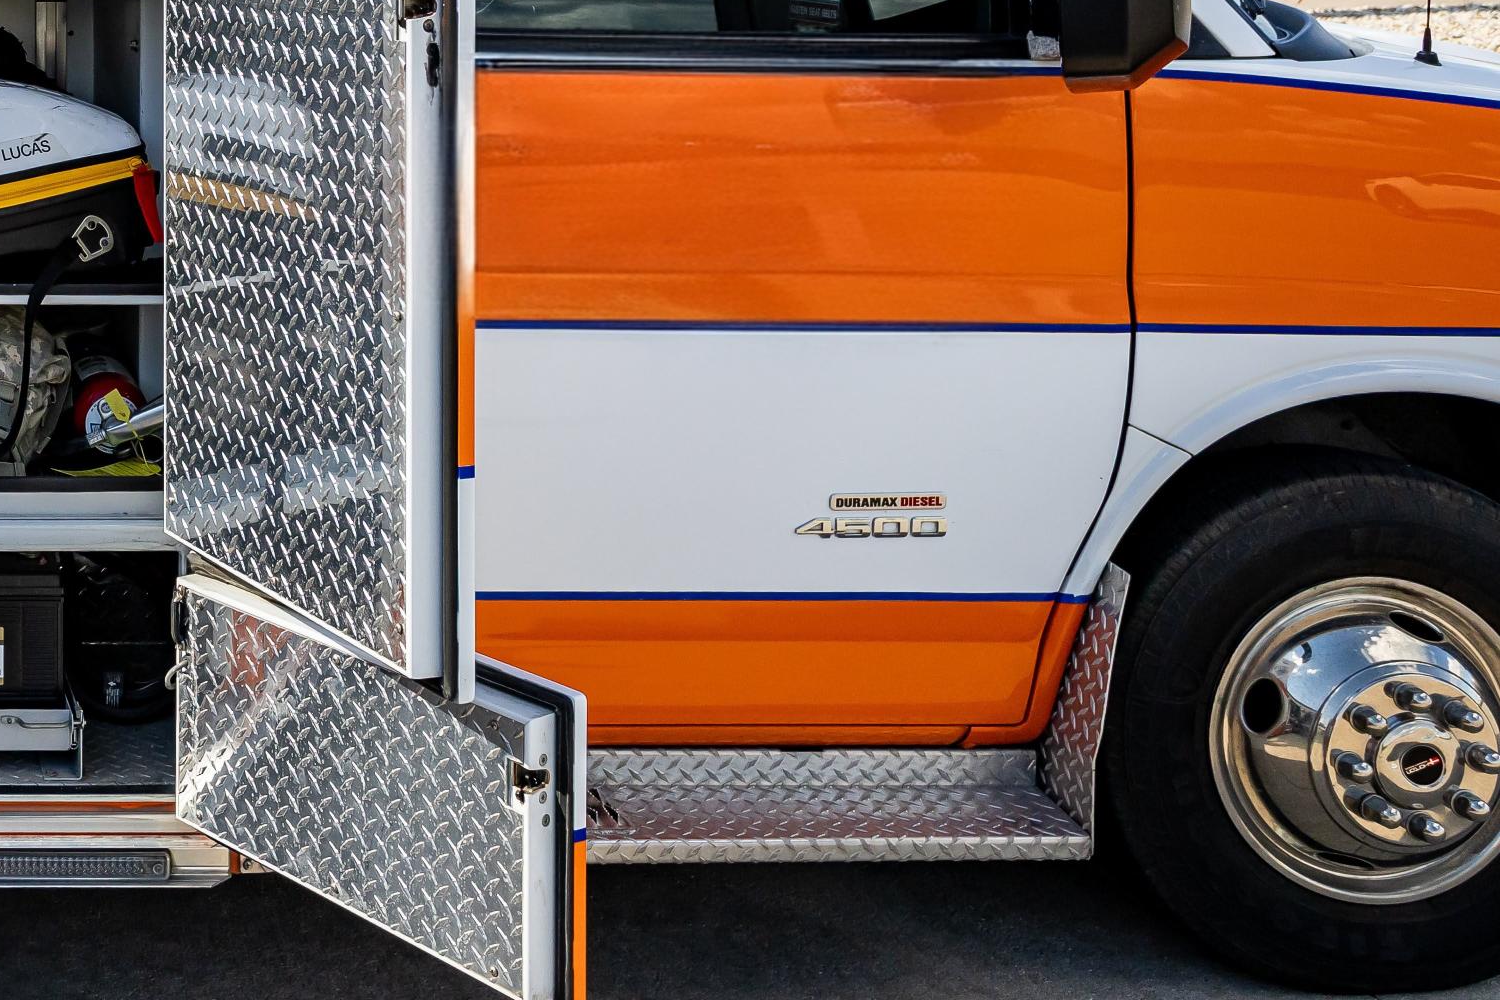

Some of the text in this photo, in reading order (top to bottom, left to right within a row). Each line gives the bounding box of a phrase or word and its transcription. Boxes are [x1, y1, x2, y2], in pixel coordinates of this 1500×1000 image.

[1, 139, 51, 162] LUCAS
[835, 496, 943, 508] DURAMAX DIESEL
[794, 515, 948, 539] 4500
